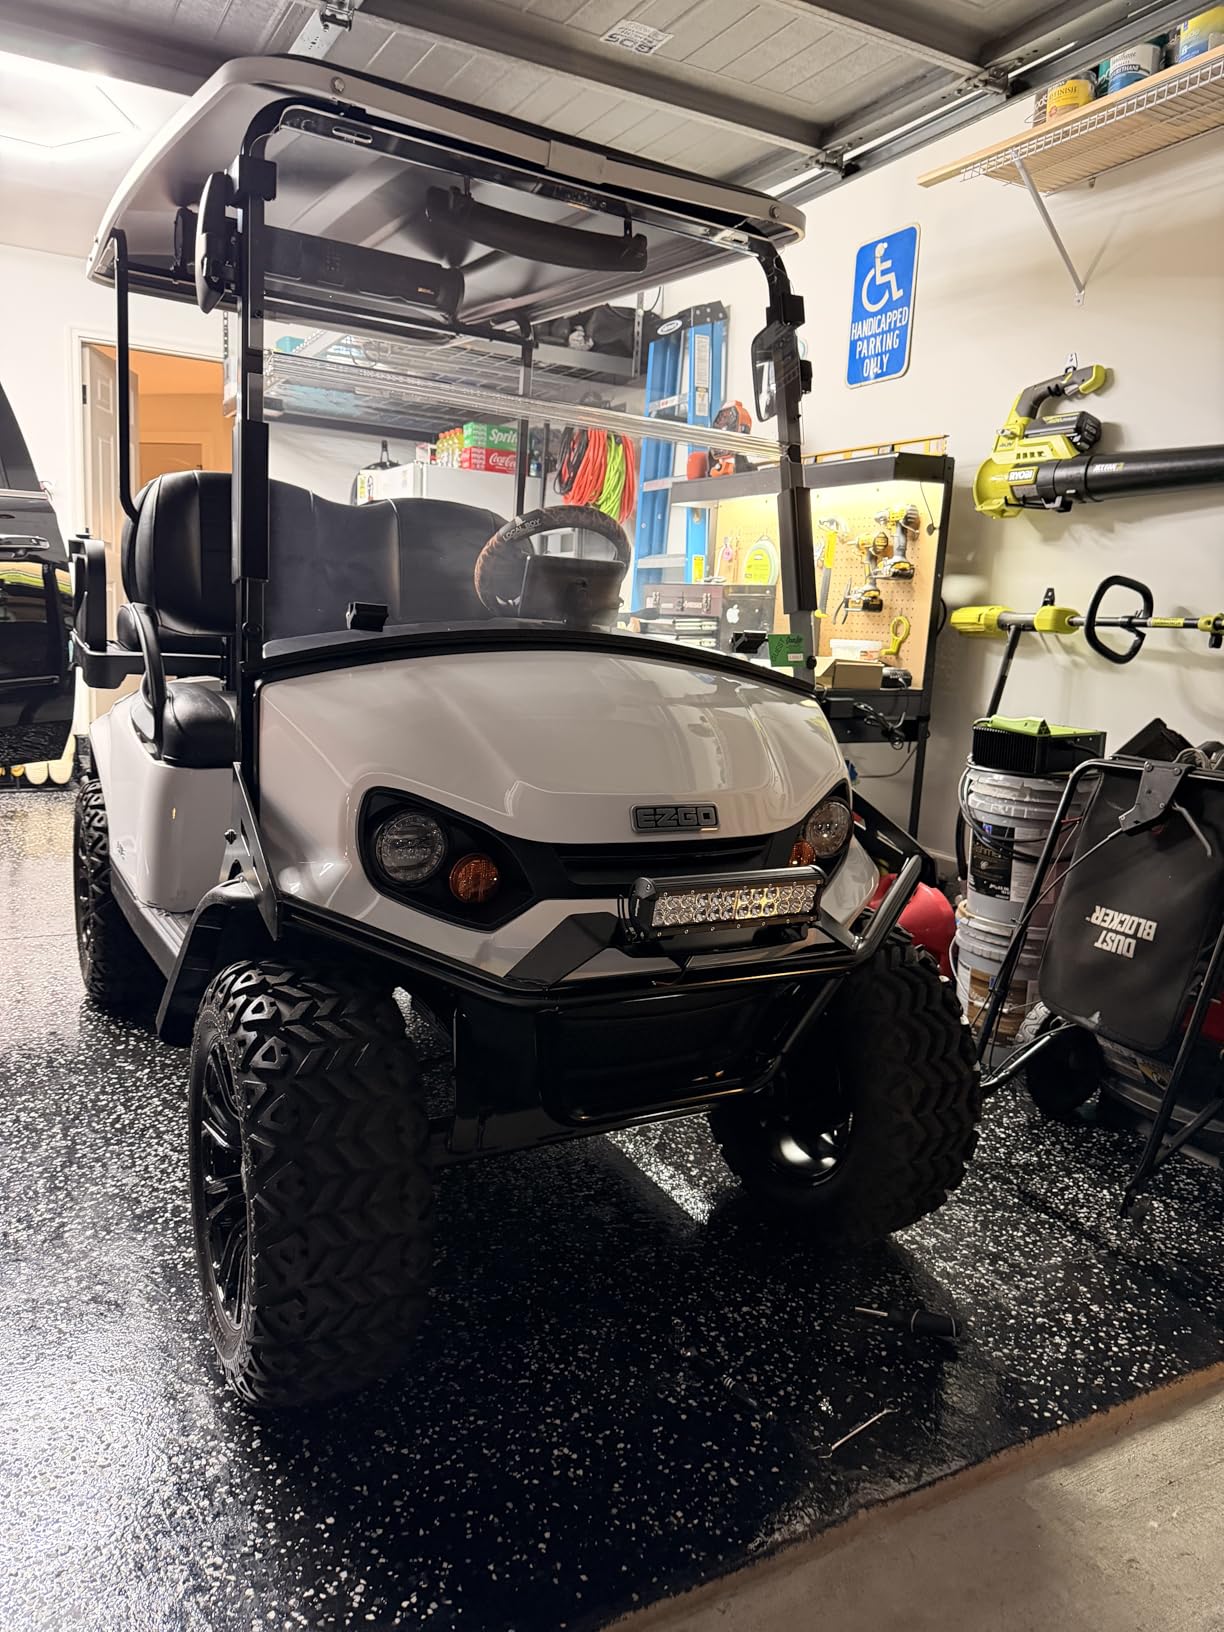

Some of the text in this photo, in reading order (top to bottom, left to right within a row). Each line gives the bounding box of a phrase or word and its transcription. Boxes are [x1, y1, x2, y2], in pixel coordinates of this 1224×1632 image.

[851, 306, 909, 341] HANDICAPPED
[856, 330, 900, 359] PARKING
[863, 353, 889, 378] ONLY
[489, 429, 517, 444] Sprit
[489, 453, 517, 468] Coca-Co
[1008, 470, 1034, 481] RYOBI
[637, 807, 717, 828] EZGO
[1090, 905, 1158, 942] BLOCKER
[1094, 930, 1136, 959] DUST
